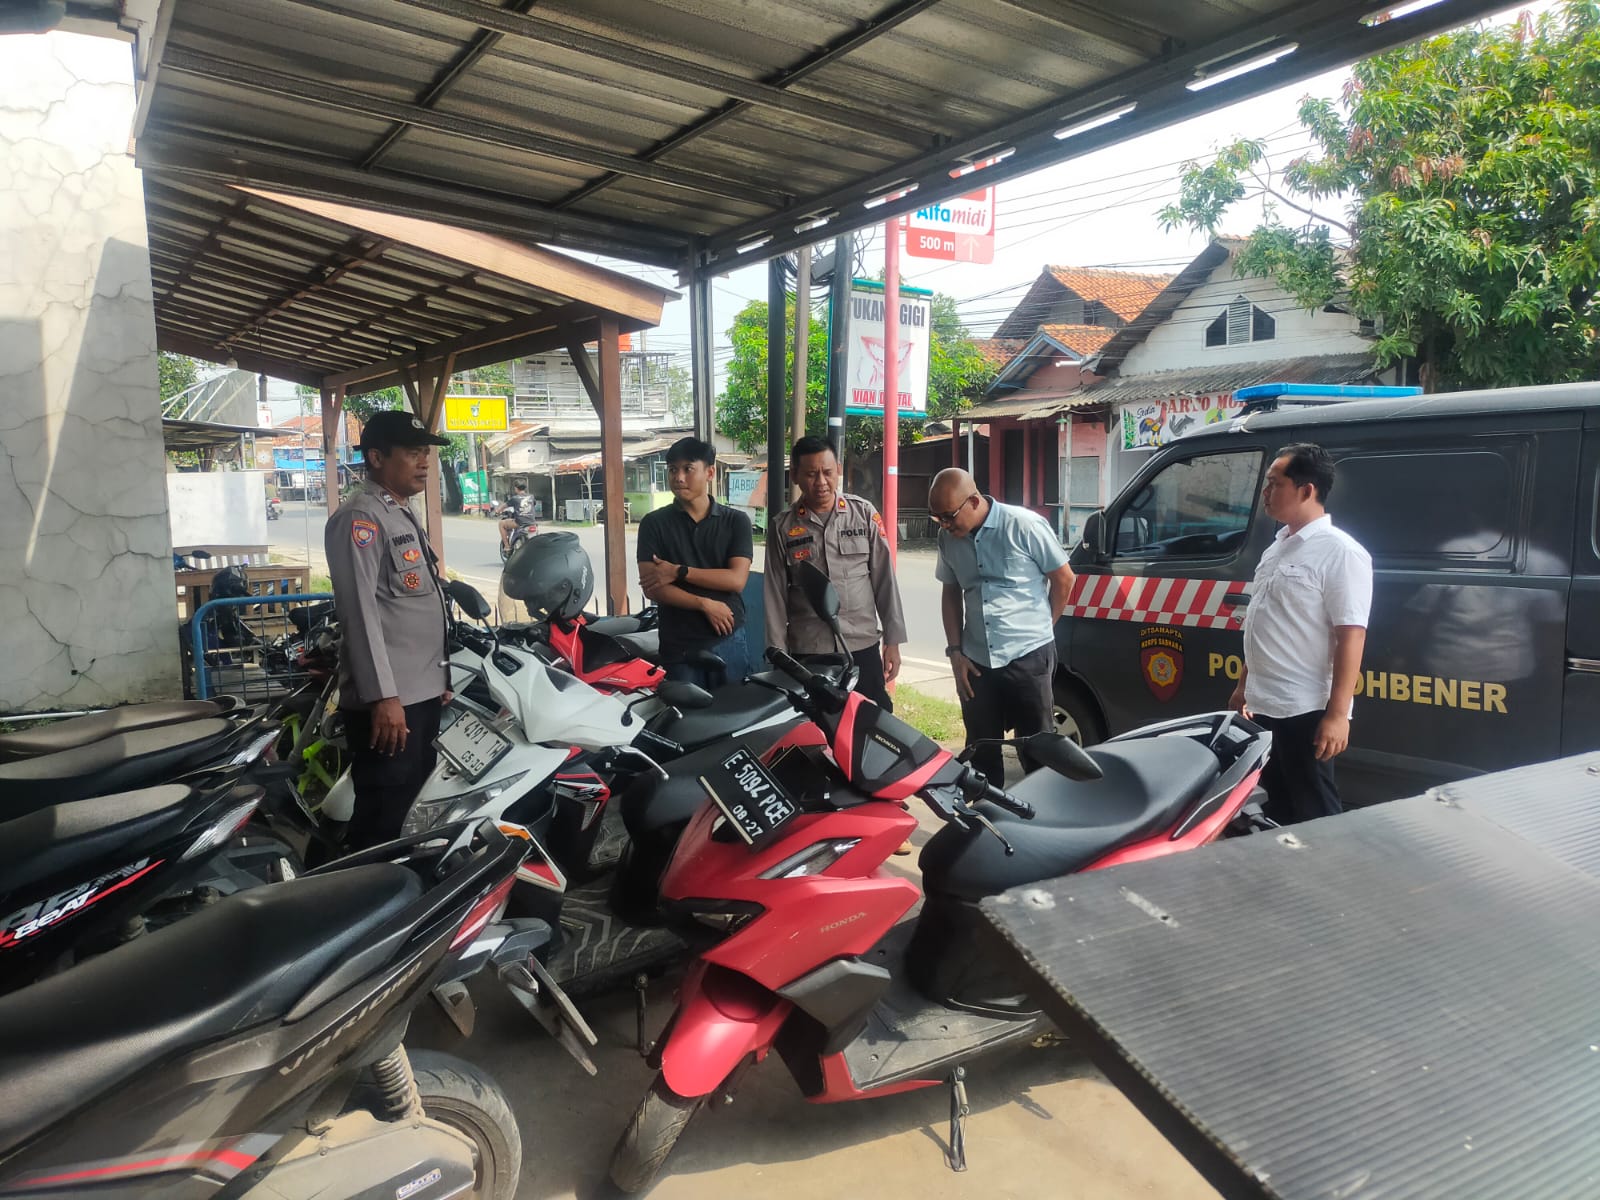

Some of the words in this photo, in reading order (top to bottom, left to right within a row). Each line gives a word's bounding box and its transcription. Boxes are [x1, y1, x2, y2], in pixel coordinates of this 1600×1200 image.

[917, 202, 986, 226] Alfamidi
[920, 235, 941, 250] 500
[943, 241, 955, 251] m
[851, 297, 885, 322] UKAN
[900, 303, 925, 328] GIGI
[852, 388, 876, 404] VIAN
[880, 391, 912, 407] DTAL
[840, 528, 866, 538] POLRI
[455, 713, 470, 728] E
[875, 734, 901, 754] HONDA
[724, 754, 743, 770] E
[734, 763, 770, 798] 5094
[758, 793, 790, 825] PCE
[820, 911, 867, 934] HONDA
